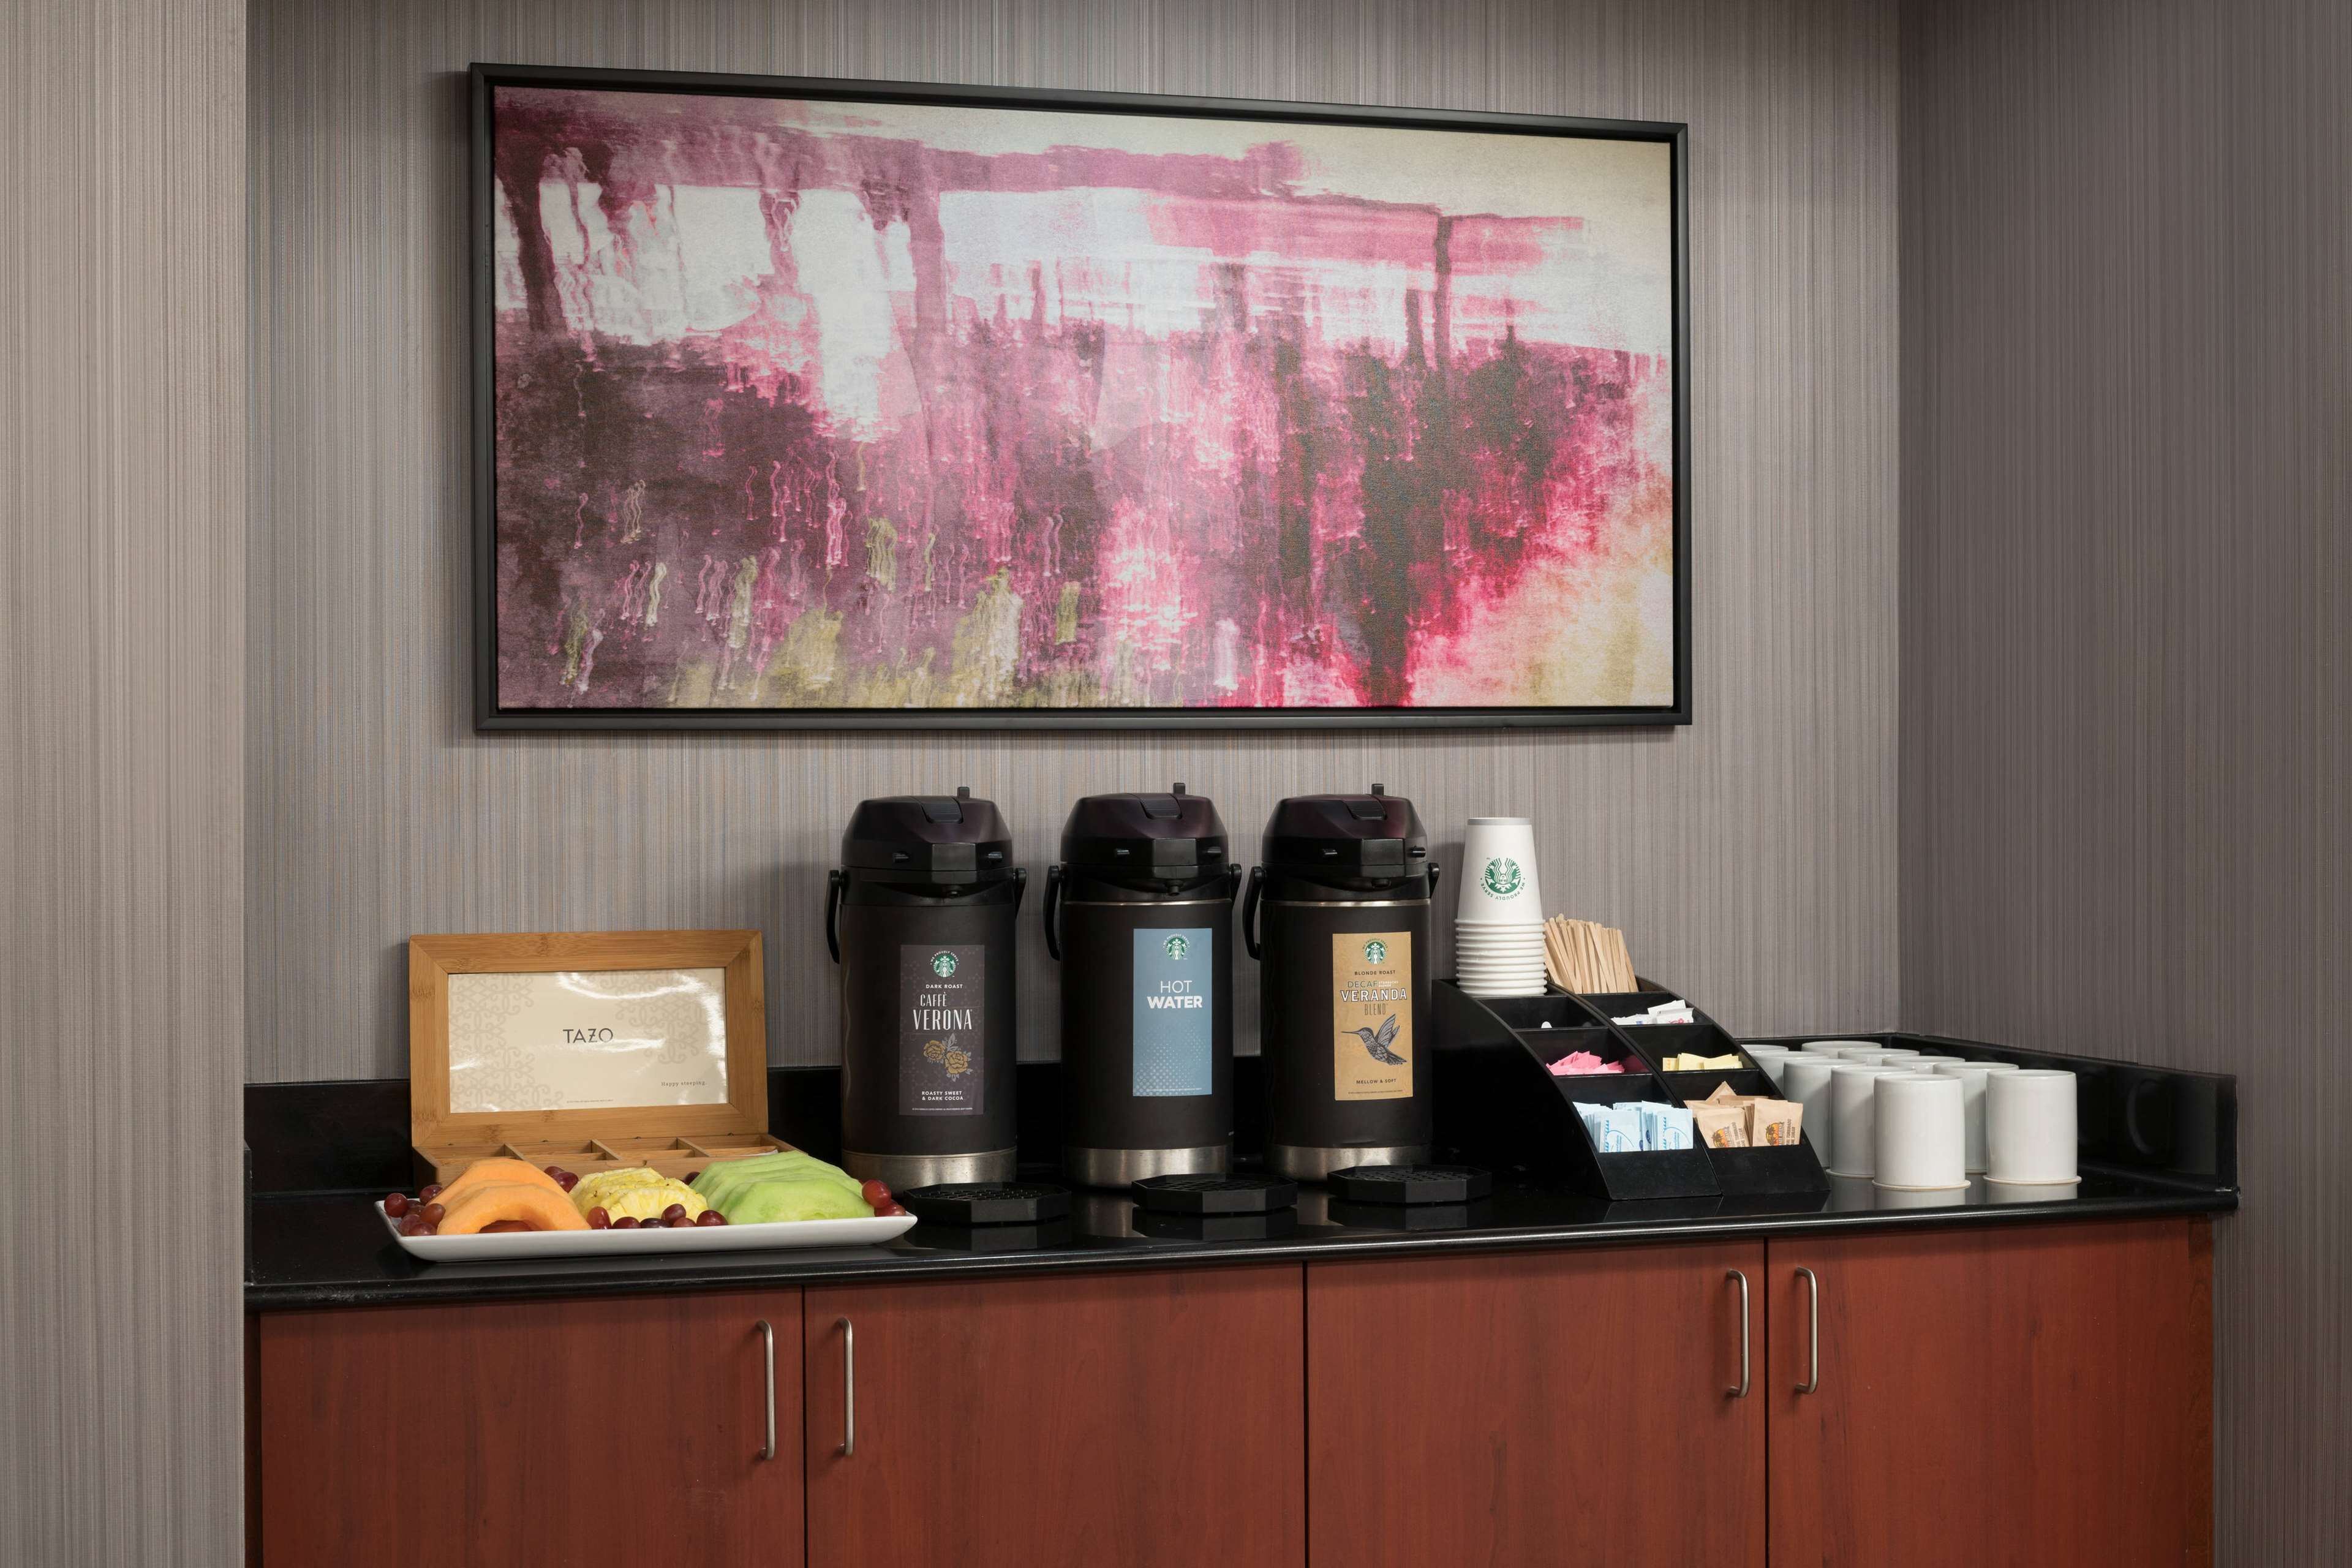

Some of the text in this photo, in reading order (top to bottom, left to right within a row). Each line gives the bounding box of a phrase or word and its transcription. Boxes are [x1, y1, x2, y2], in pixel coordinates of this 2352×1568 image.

[1480, 883, 1493, 897] SERVE
[1494, 891, 1520, 901] PROUDLY
[1160, 981, 1193, 993] HOT
[921, 992, 947, 1006] CAFFÈ
[1147, 995, 1203, 1009] WATER
[1340, 988, 1408, 1003] VERANDA
[1365, 1003, 1387, 1016] BLEND
[913, 1009, 973, 1030] VERONA
[562, 1028, 614, 1044] TAZO
